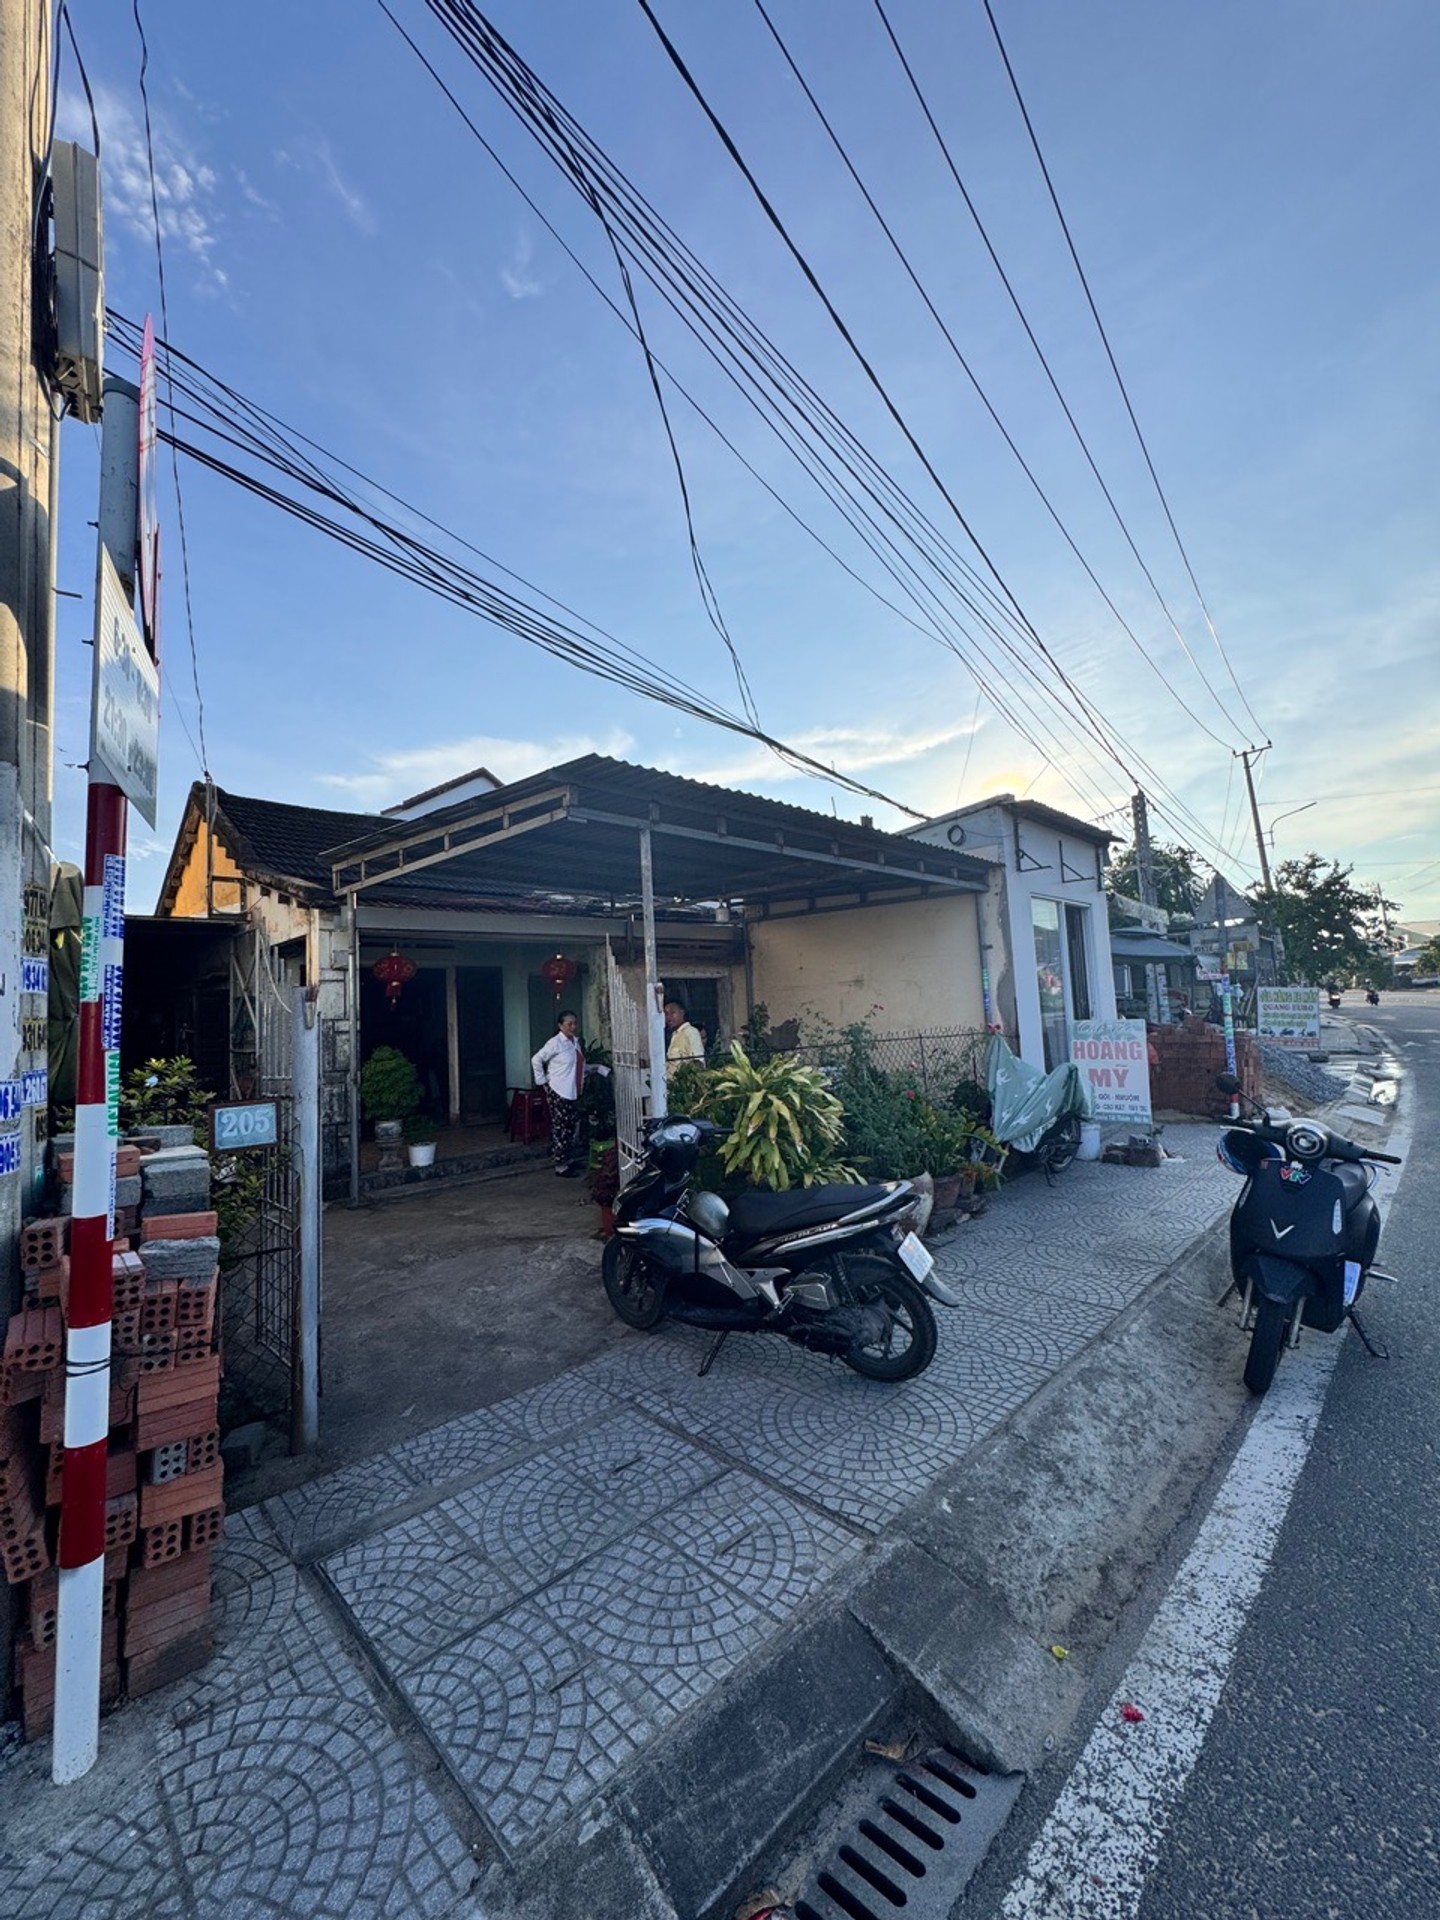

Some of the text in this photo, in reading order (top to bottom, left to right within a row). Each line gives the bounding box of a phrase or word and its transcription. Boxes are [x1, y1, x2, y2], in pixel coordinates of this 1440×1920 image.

[1072, 1036, 1142, 1060] HOÀNG
[1088, 1064, 1129, 1088] MỸ
[220, 1109, 270, 1138] 205
